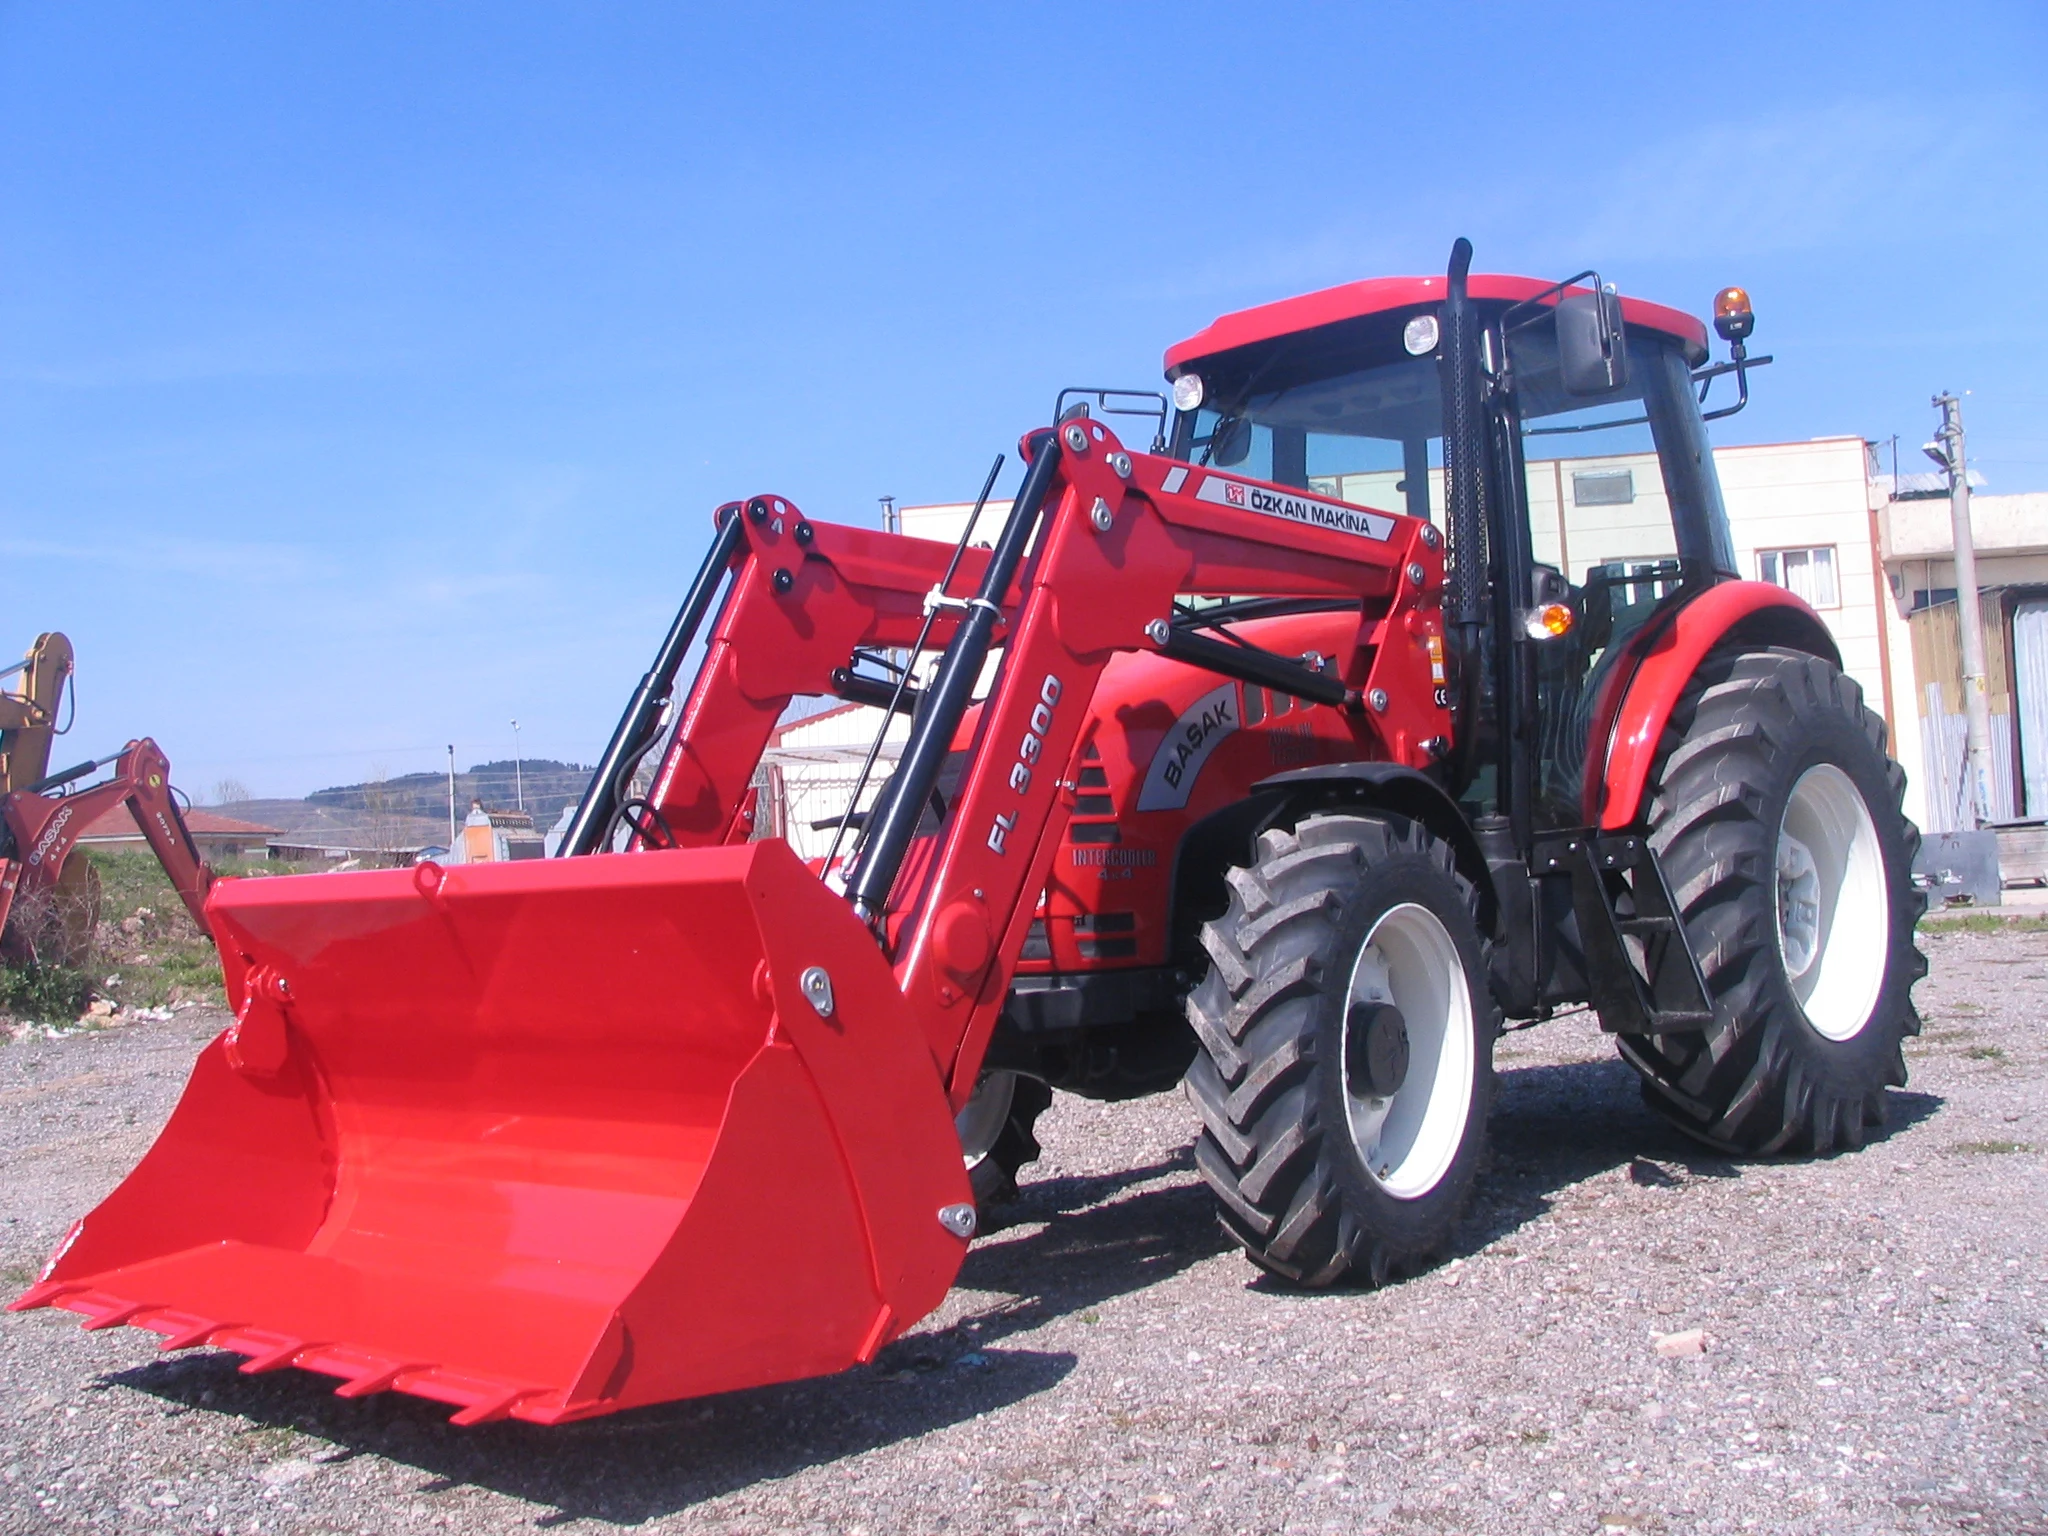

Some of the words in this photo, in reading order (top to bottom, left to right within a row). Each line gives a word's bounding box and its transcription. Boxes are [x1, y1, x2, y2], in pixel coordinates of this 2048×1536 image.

[1251, 488, 1307, 520] ÖZKAN
[1311, 505, 1371, 535] MAKİNA
[1434, 689, 1448, 705] CE
[987, 809, 1019, 856] FL
[1009, 674, 1063, 795] 3300
[1072, 849, 1157, 867] INTERCOOLER
